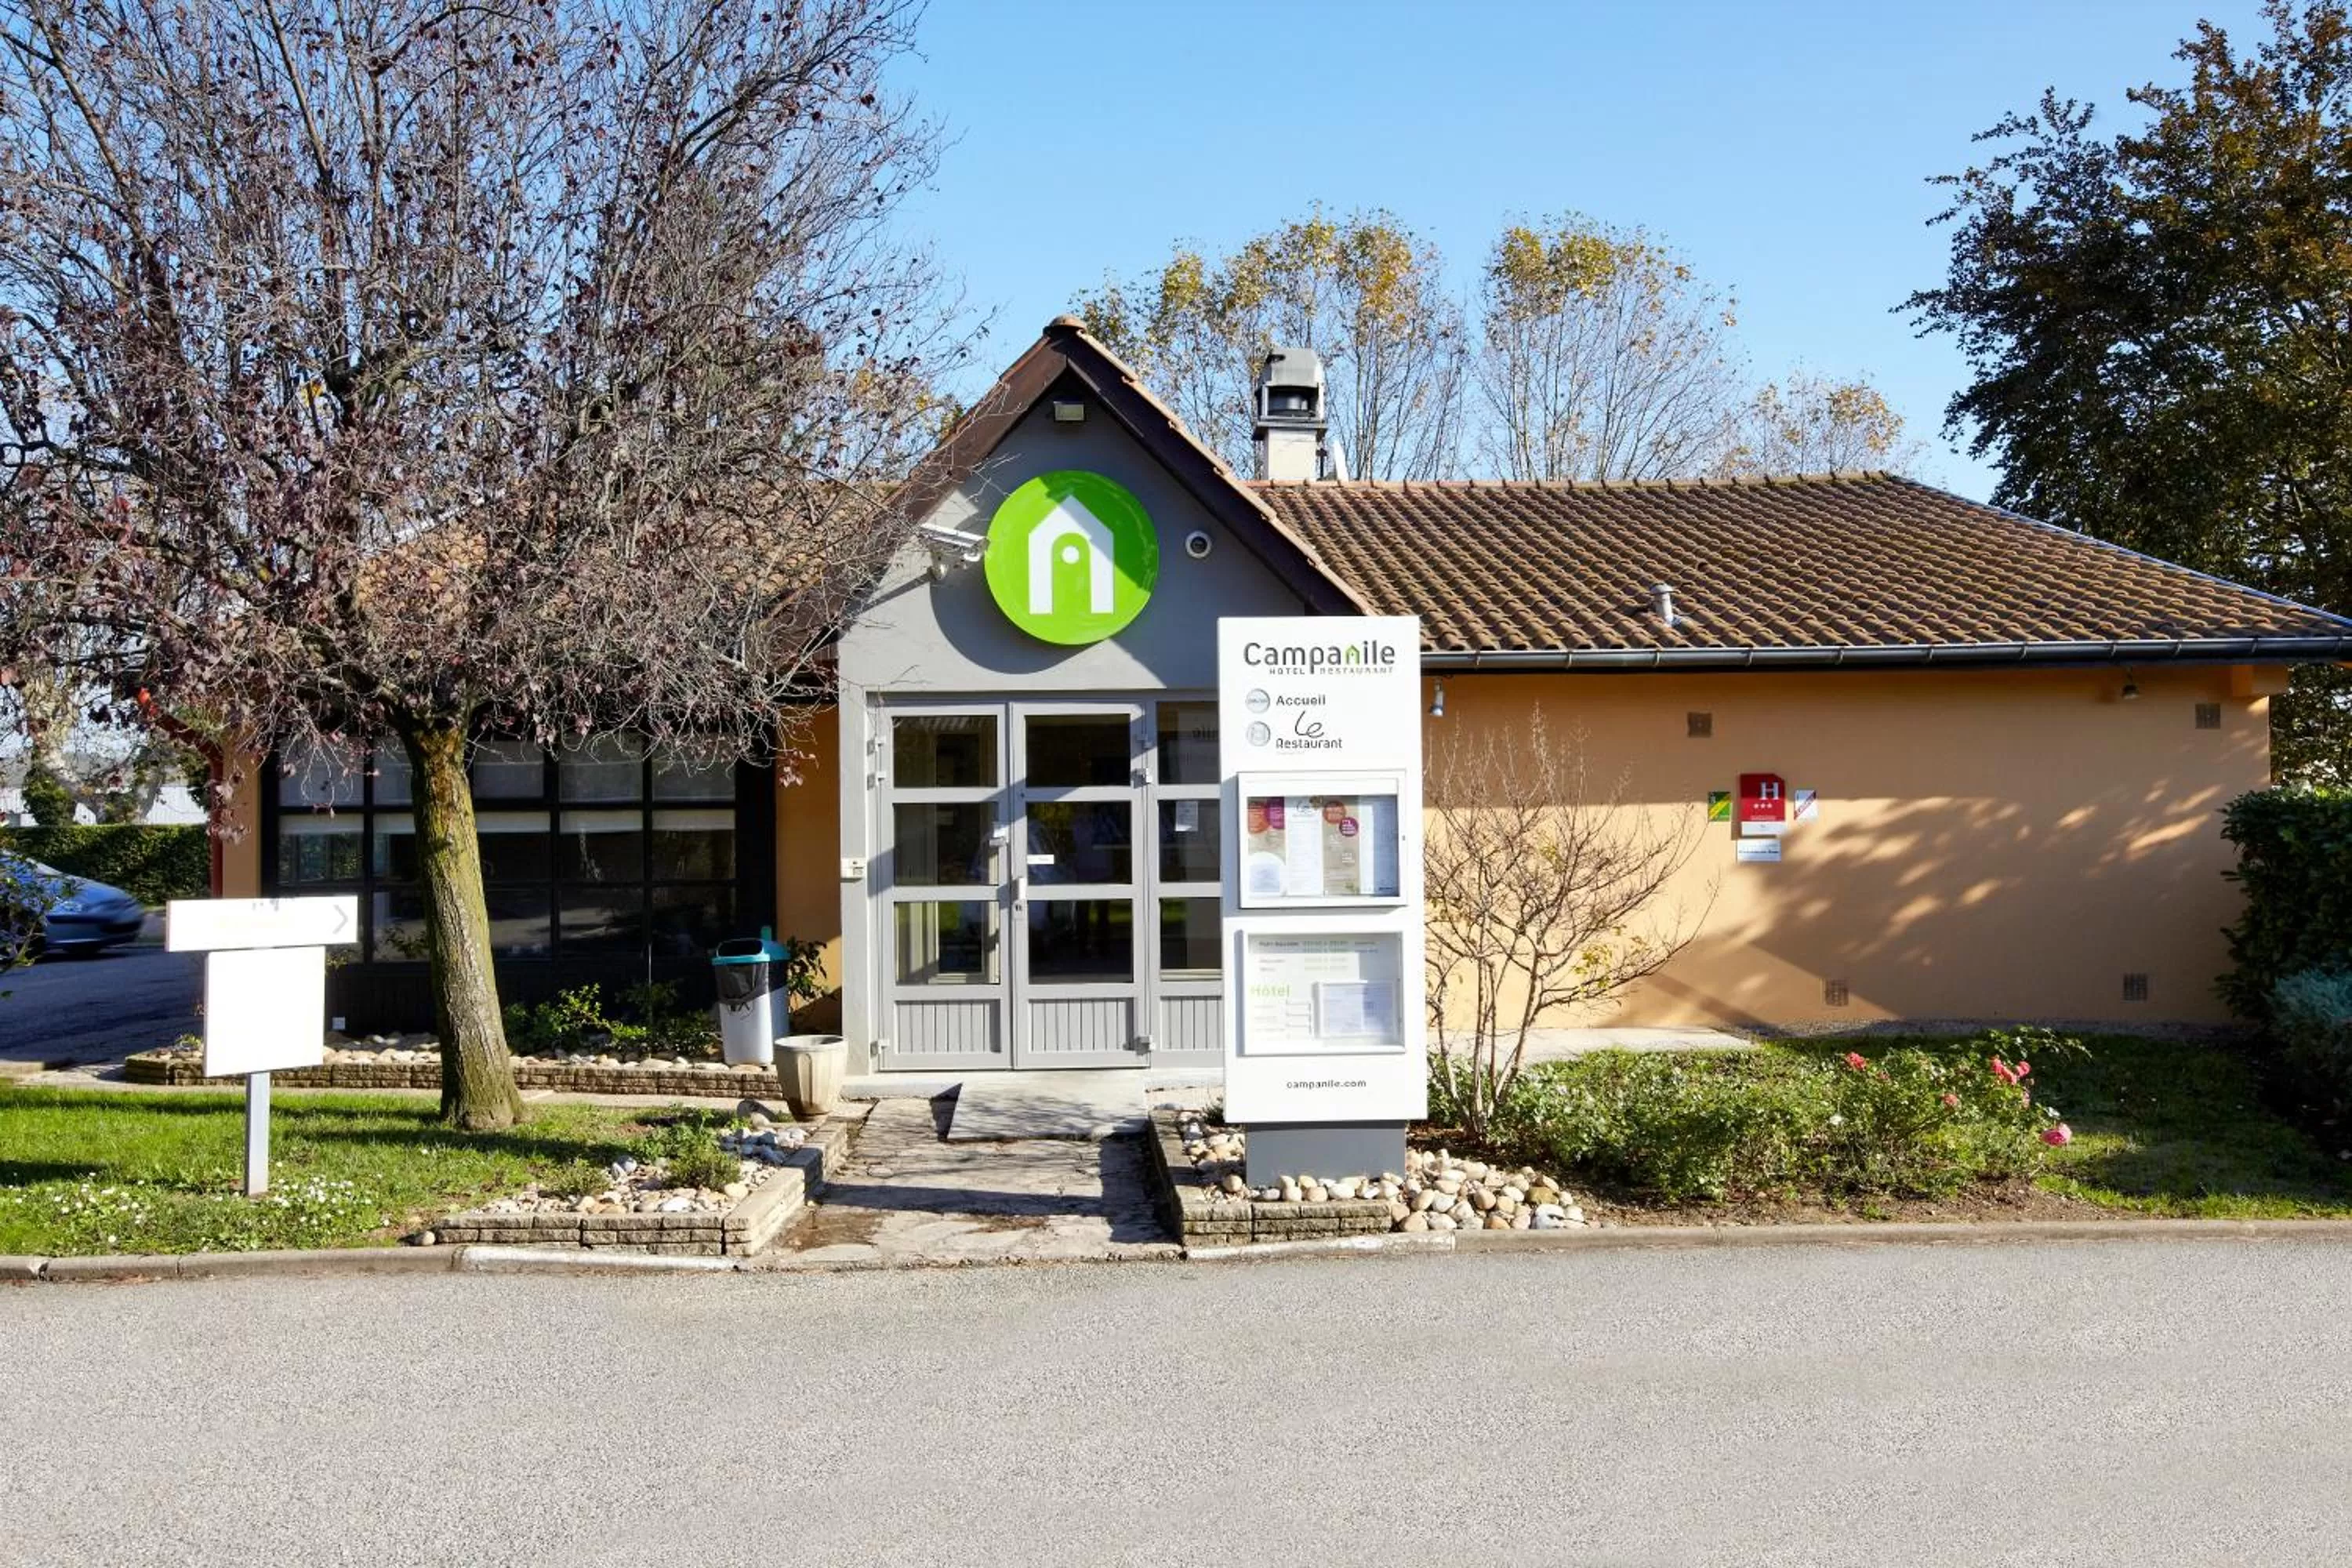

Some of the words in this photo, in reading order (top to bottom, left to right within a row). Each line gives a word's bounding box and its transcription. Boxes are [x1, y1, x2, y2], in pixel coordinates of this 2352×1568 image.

[1243, 640, 1396, 674] Campanile
[1276, 695, 1326, 706] Accueil
[1276, 739, 1343, 749] Restaurant
[1760, 781, 1780, 800] H
[1287, 1079, 1367, 1090] campanile.com
